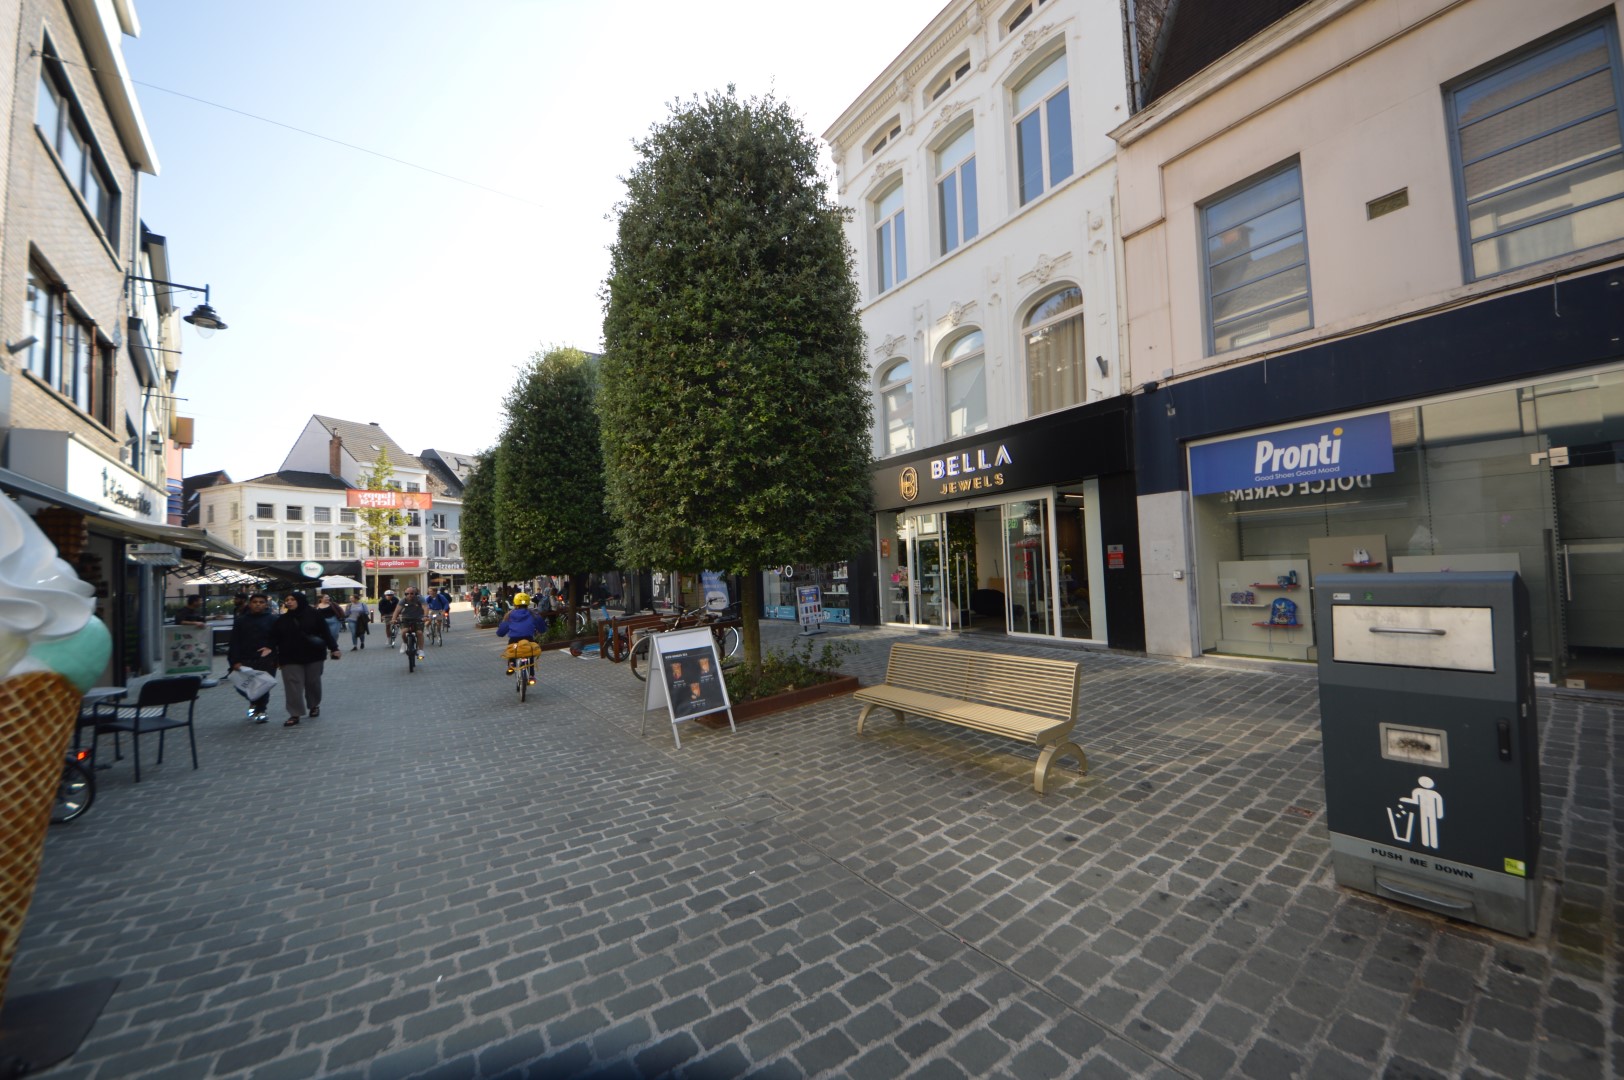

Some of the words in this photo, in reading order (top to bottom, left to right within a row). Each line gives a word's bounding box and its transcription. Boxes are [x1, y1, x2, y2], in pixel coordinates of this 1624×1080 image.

[931, 445, 1013, 479] BELLA
[1254, 427, 1343, 474] Pronti
[940, 472, 1004, 495] JEWELS
[1254, 474, 1274, 482] Good
[1274, 472, 1295, 480] Shoes
[1296, 468, 1316, 477] Good
[1317, 466, 1340, 475] Mood
[1371, 847, 1403, 861] PUSH
[1410, 857, 1428, 868] ME
[1435, 863, 1474, 879] DOWN
